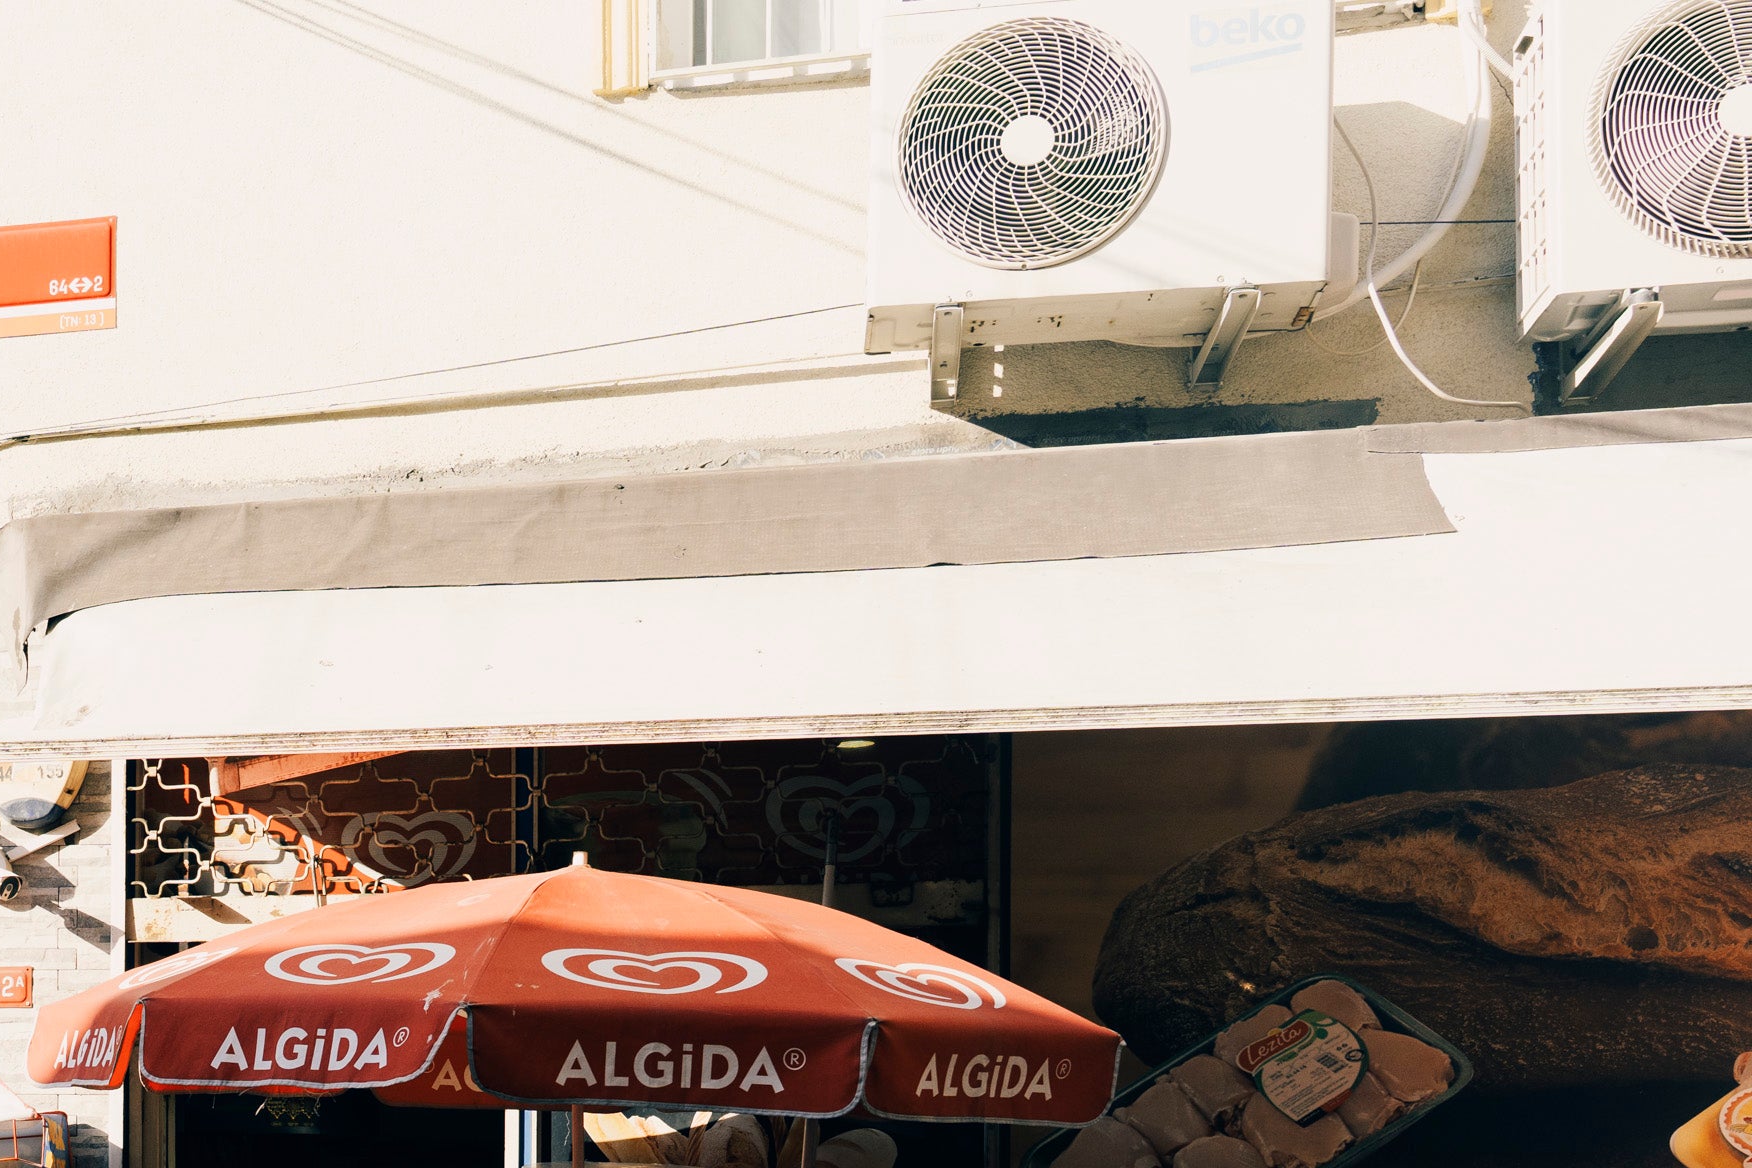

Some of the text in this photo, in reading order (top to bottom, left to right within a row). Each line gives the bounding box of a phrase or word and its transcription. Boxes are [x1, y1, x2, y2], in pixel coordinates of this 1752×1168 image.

[1190, 8, 1306, 48] beko
[93, 276, 103, 292] 2
[211, 1027, 389, 1071] ALGiDA
[555, 1038, 785, 1094] ALGiDA
[1247, 1026, 1302, 1066] Lezita
[915, 1053, 1053, 1102] ALGiDA
